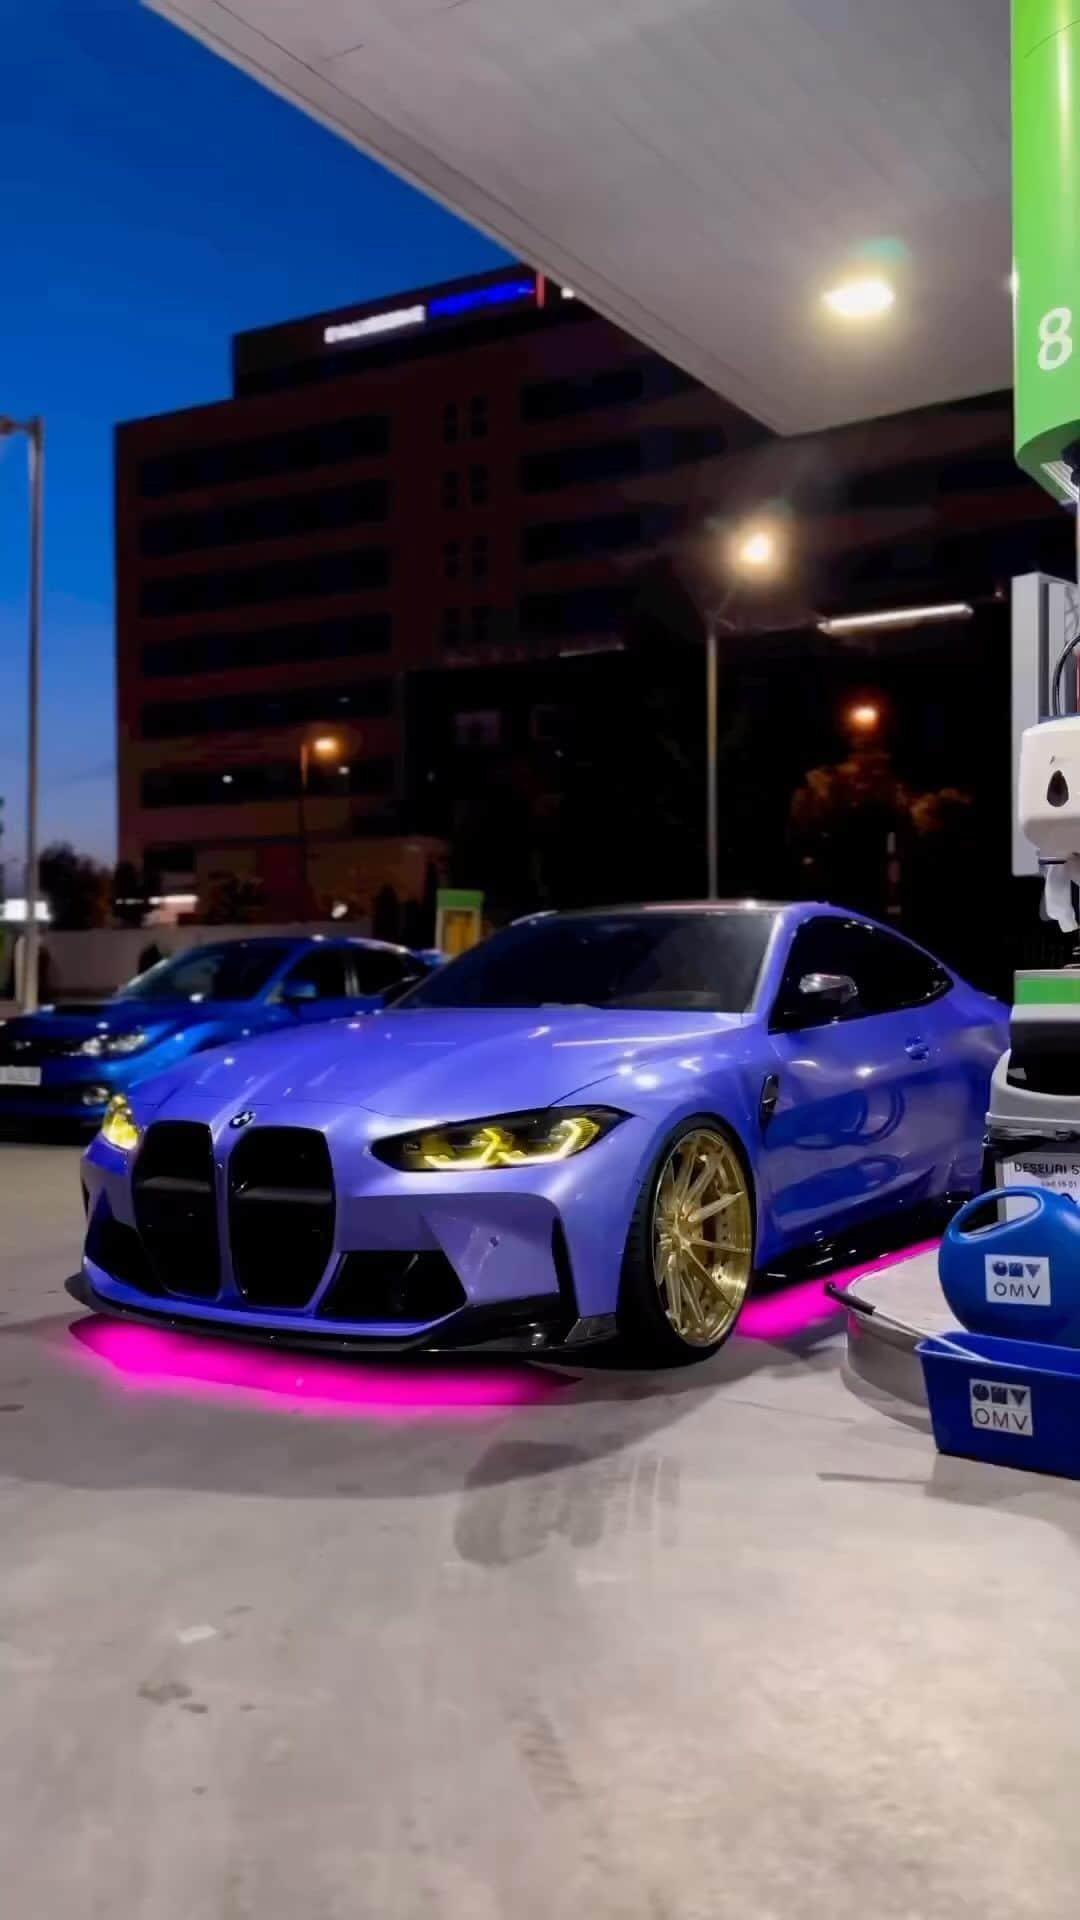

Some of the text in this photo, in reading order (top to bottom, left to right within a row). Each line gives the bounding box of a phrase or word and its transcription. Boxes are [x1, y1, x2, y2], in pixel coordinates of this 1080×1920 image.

[1038, 307, 1073, 370] 8
[993, 1281, 1041, 1299] OMV
[974, 1407, 1028, 1431] OMV
